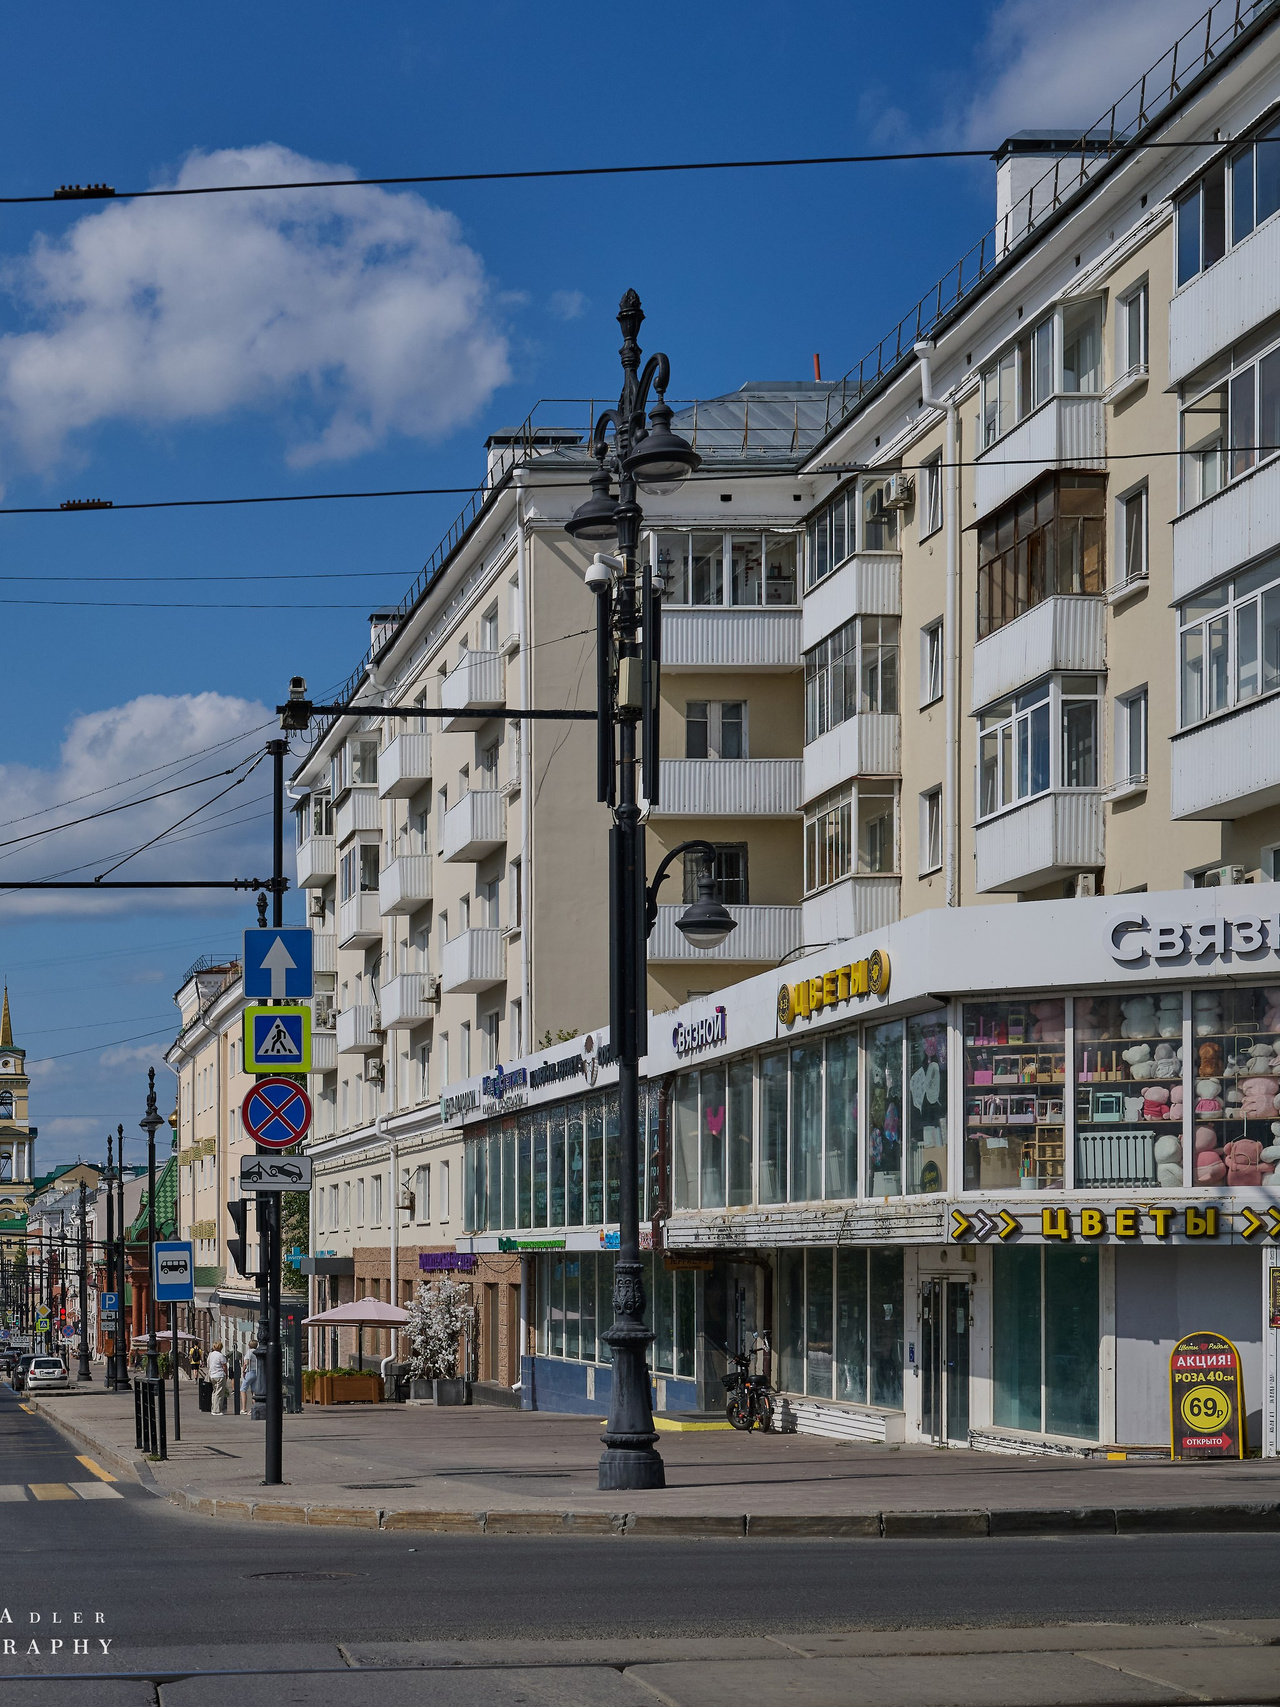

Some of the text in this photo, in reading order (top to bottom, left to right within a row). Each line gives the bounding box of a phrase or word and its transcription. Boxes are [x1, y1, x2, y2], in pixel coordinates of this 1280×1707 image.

[795, 960, 869, 1016] ЦВЕТЫ
[1042, 1208, 1216, 1240] ЦВЕТЫ
[105, 1295, 116, 1308] P
[1177, 1354, 1232, 1368] АКЦИЯ!
[1175, 1372, 1206, 1383] РОЗА
[1186, 1438, 1222, 1446] ОТКРЫТО
